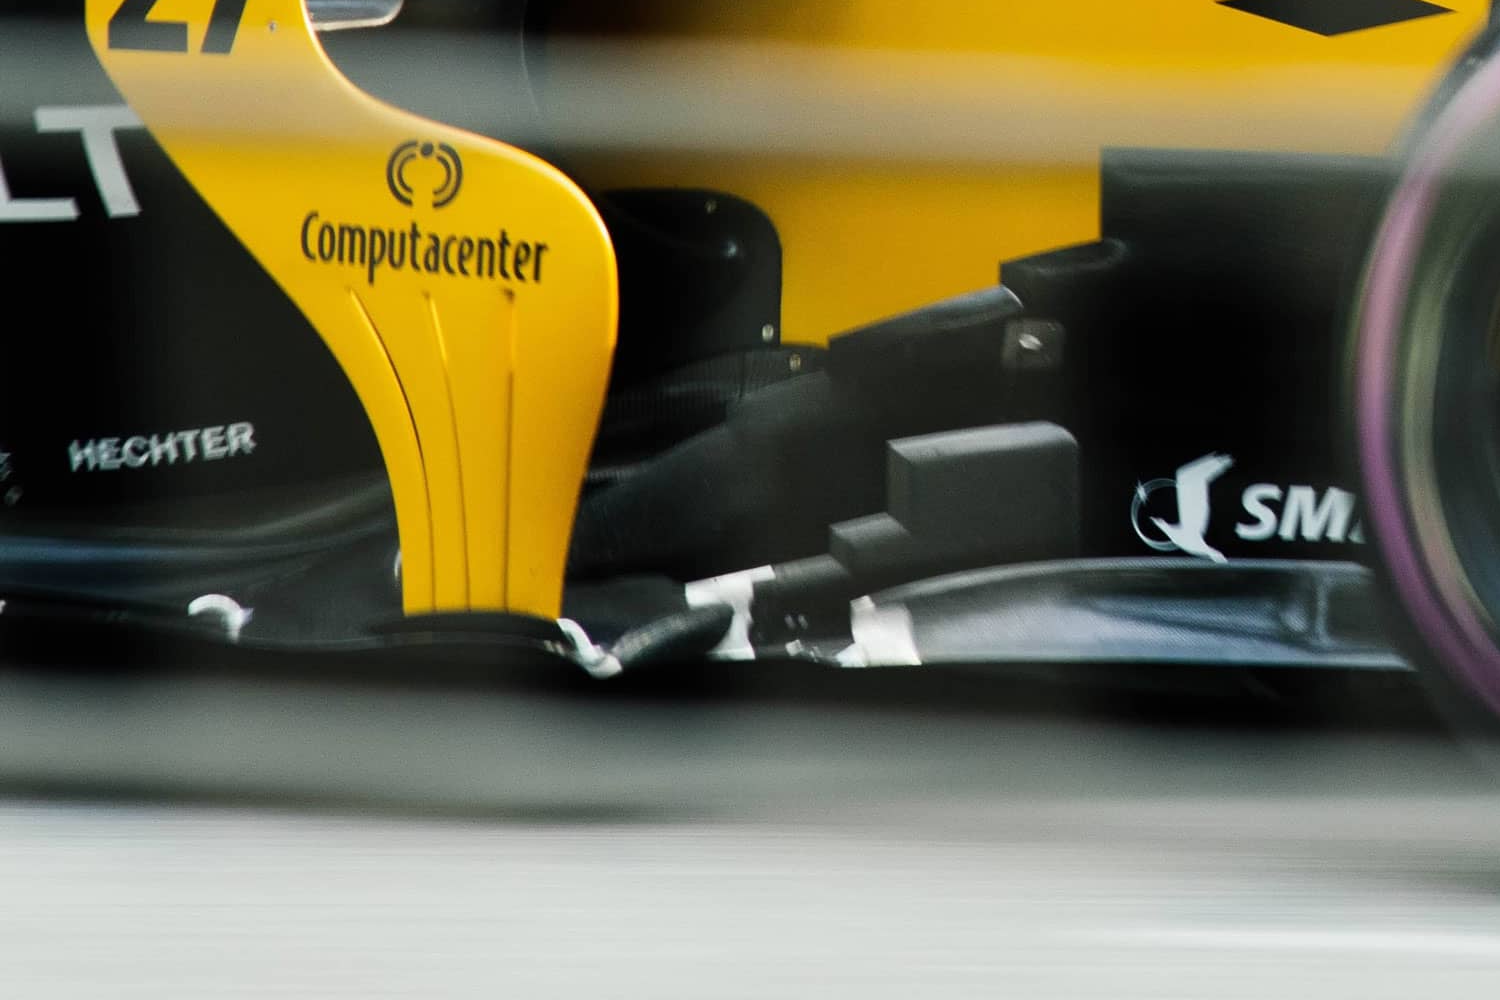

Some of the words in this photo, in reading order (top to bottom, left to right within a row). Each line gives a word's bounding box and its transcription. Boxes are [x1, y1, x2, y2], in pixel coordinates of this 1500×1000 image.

[301, 210, 548, 287] Computacenter
[68, 421, 257, 473] HECHTER
[1234, 482, 1366, 545] SM
